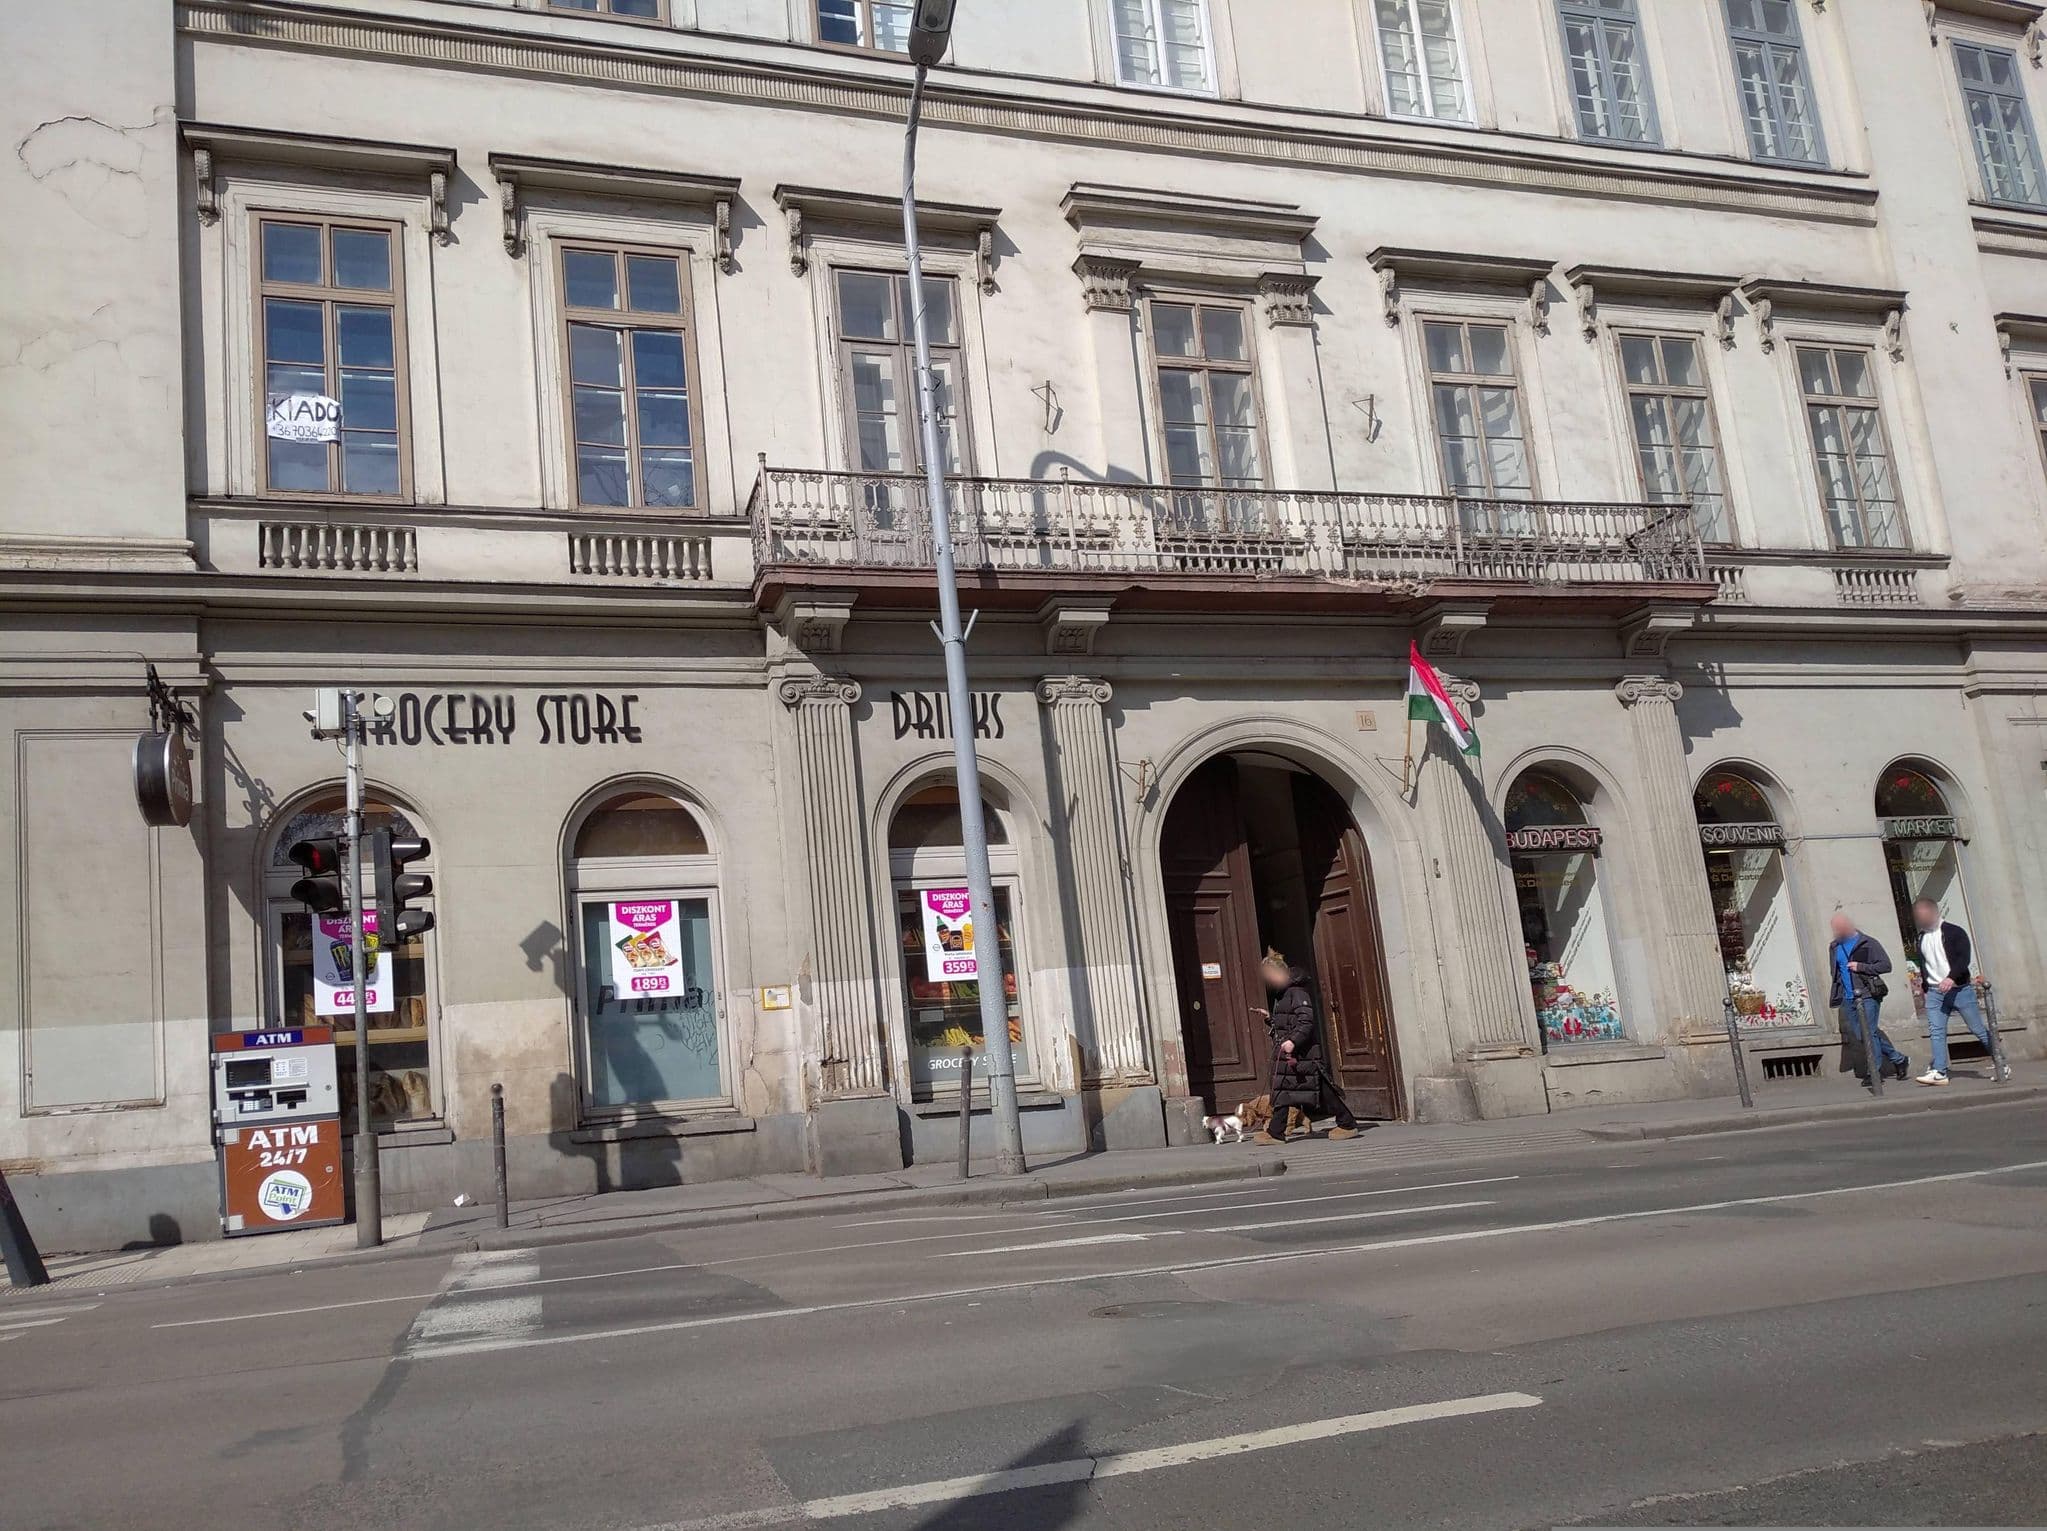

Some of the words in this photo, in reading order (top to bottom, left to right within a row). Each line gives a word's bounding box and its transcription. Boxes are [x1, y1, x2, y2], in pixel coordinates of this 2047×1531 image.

[536, 692, 643, 745] STORE
[890, 690, 1004, 740] DRIKS
[1360, 714, 1372, 727] 16
[1892, 819, 1954, 836] MARKET
[1505, 828, 1600, 849] BUDAPEST
[1701, 826, 1784, 844] SOUVENIR
[621, 904, 667, 915] DISZKONT
[945, 961, 967, 973] 359
[633, 978, 658, 990] 189
[255, 1032, 292, 1046] ATM
[928, 1056, 980, 1070] GROCEY
[247, 1125, 319, 1150] ATM
[260, 1148, 308, 1168] 24/7
[271, 1185, 299, 1197] ATM
[268, 1192, 297, 1205] Point
